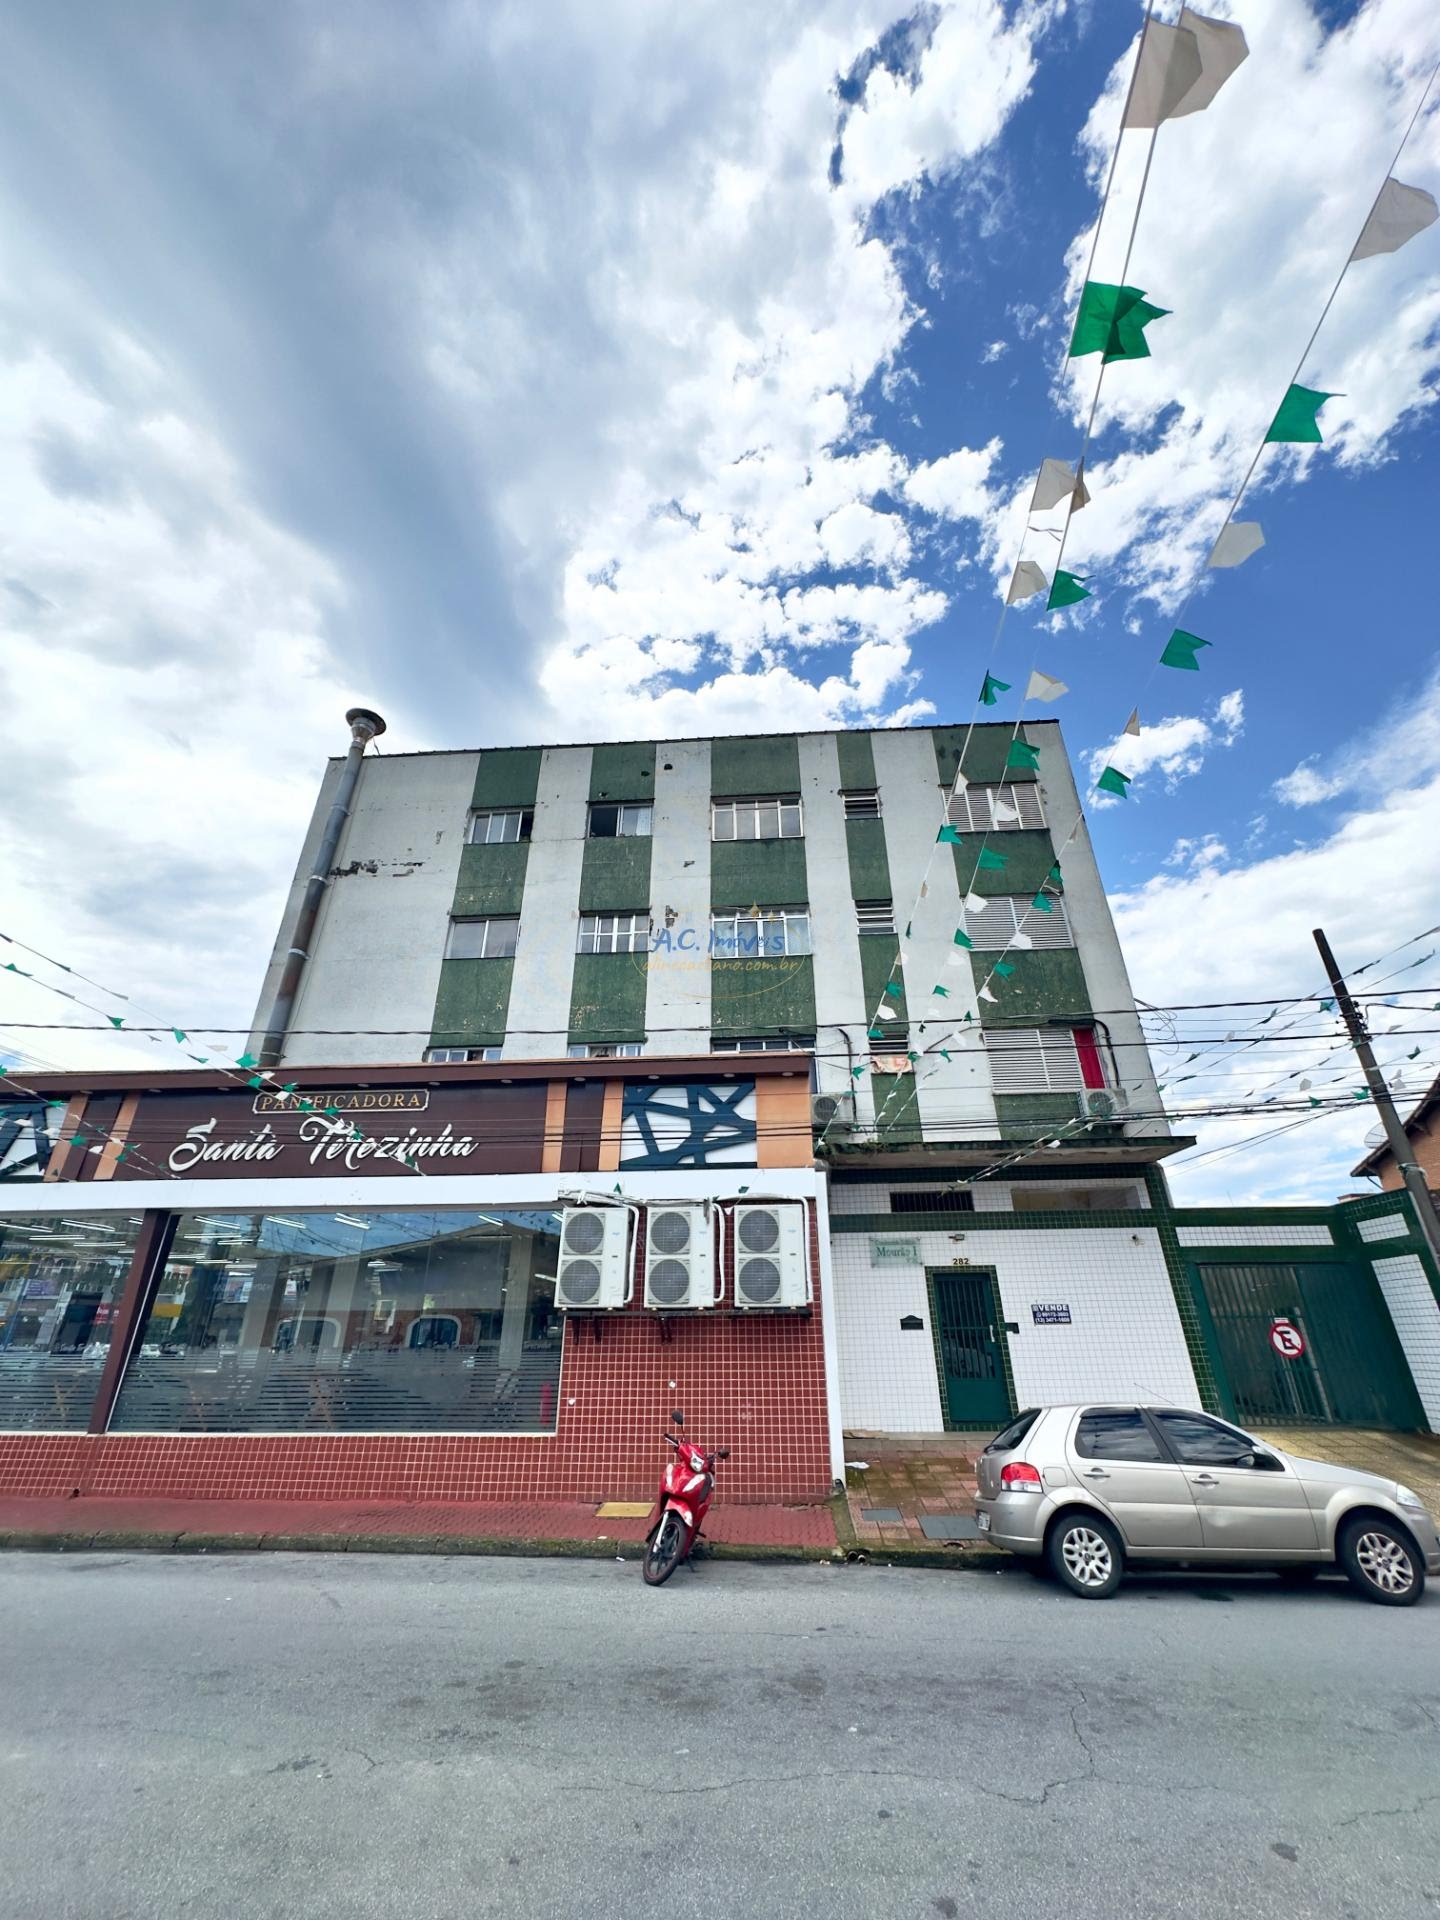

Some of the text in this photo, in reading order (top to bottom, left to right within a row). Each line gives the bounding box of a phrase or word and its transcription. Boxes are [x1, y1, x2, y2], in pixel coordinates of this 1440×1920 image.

[261, 1092, 422, 1111] PANFICADORA
[168, 1116, 479, 1172] Santa Terezinha
[953, 1258, 970, 1266] 282
